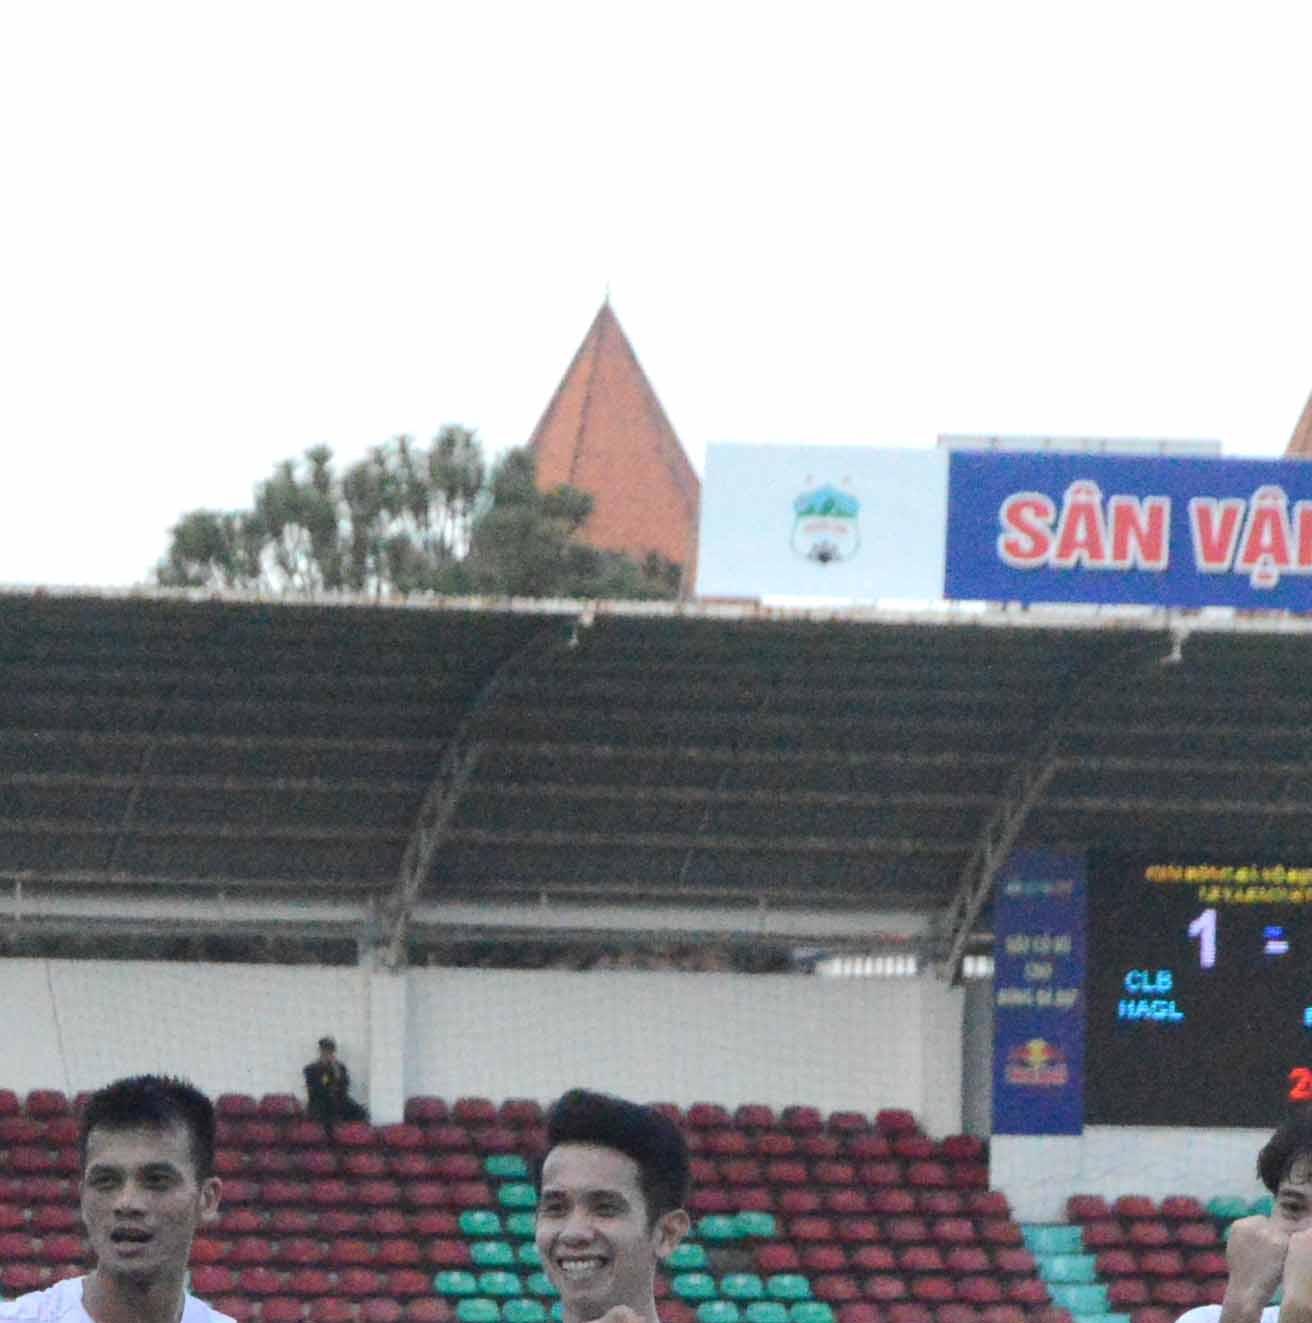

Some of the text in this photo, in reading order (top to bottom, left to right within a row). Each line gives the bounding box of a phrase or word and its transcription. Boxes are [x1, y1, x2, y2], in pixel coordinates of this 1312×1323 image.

[998, 479, 1171, 571] SÂN
[1187, 907, 1218, 970] 1
[1118, 998, 1185, 1021] HAGL
